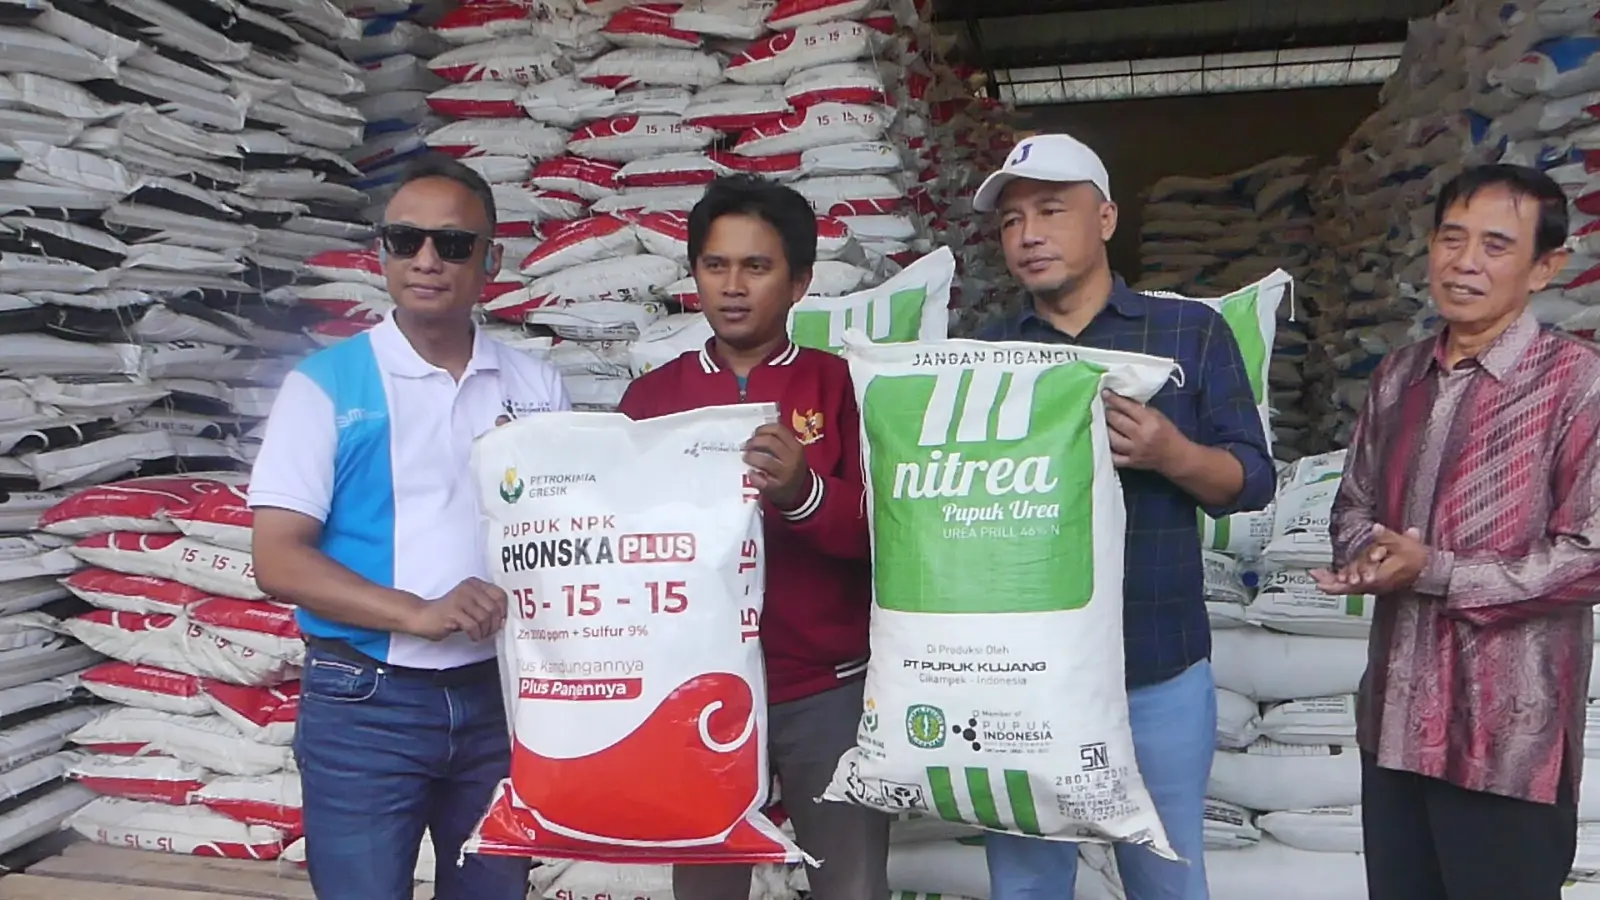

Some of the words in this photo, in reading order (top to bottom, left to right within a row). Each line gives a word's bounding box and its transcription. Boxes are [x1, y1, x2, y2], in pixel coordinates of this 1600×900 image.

[912, 350, 986, 366] JANGAN
[530, 473, 597, 486] PETROKIMIA
[892, 450, 1058, 500] nitrea
[529, 486, 569, 498] GRESIK
[942, 502, 1004, 526] Pupuk
[1009, 500, 1060, 519] Urea
[503, 518, 560, 539] PUPUK
[571, 515, 616, 531] NPK
[943, 527, 977, 539] UREA
[981, 526, 1016, 538] PRILL
[1051, 524, 1060, 535] N
[181, 547, 199, 562] 15
[212, 554, 230, 570] 15
[501, 535, 615, 573] PHONSKA
[623, 535, 694, 560] PLUS
[738, 539, 758, 574] 15
[513, 588, 537, 619] 15
[561, 584, 602, 617] 15
[645, 581, 688, 614] 15
[186, 622, 204, 638] 15
[583, 625, 624, 638] Sulfur
[628, 624, 649, 636] 9%
[741, 607, 760, 643] 15
[927, 644, 936, 654] Di
[939, 644, 983, 655] Produksi
[985, 644, 1010, 655] Oleh
[903, 659, 920, 670] PT
[921, 661, 974, 672] PUPUK
[978, 661, 1047, 673] KUJANG
[919, 673, 967, 687] Cikampek
[977, 675, 1027, 686] Indonesia
[521, 679, 549, 695] Plus
[551, 681, 627, 698] Panennya
[982, 719, 1051, 731] PUPUK
[984, 731, 1053, 741] INDONESIA
